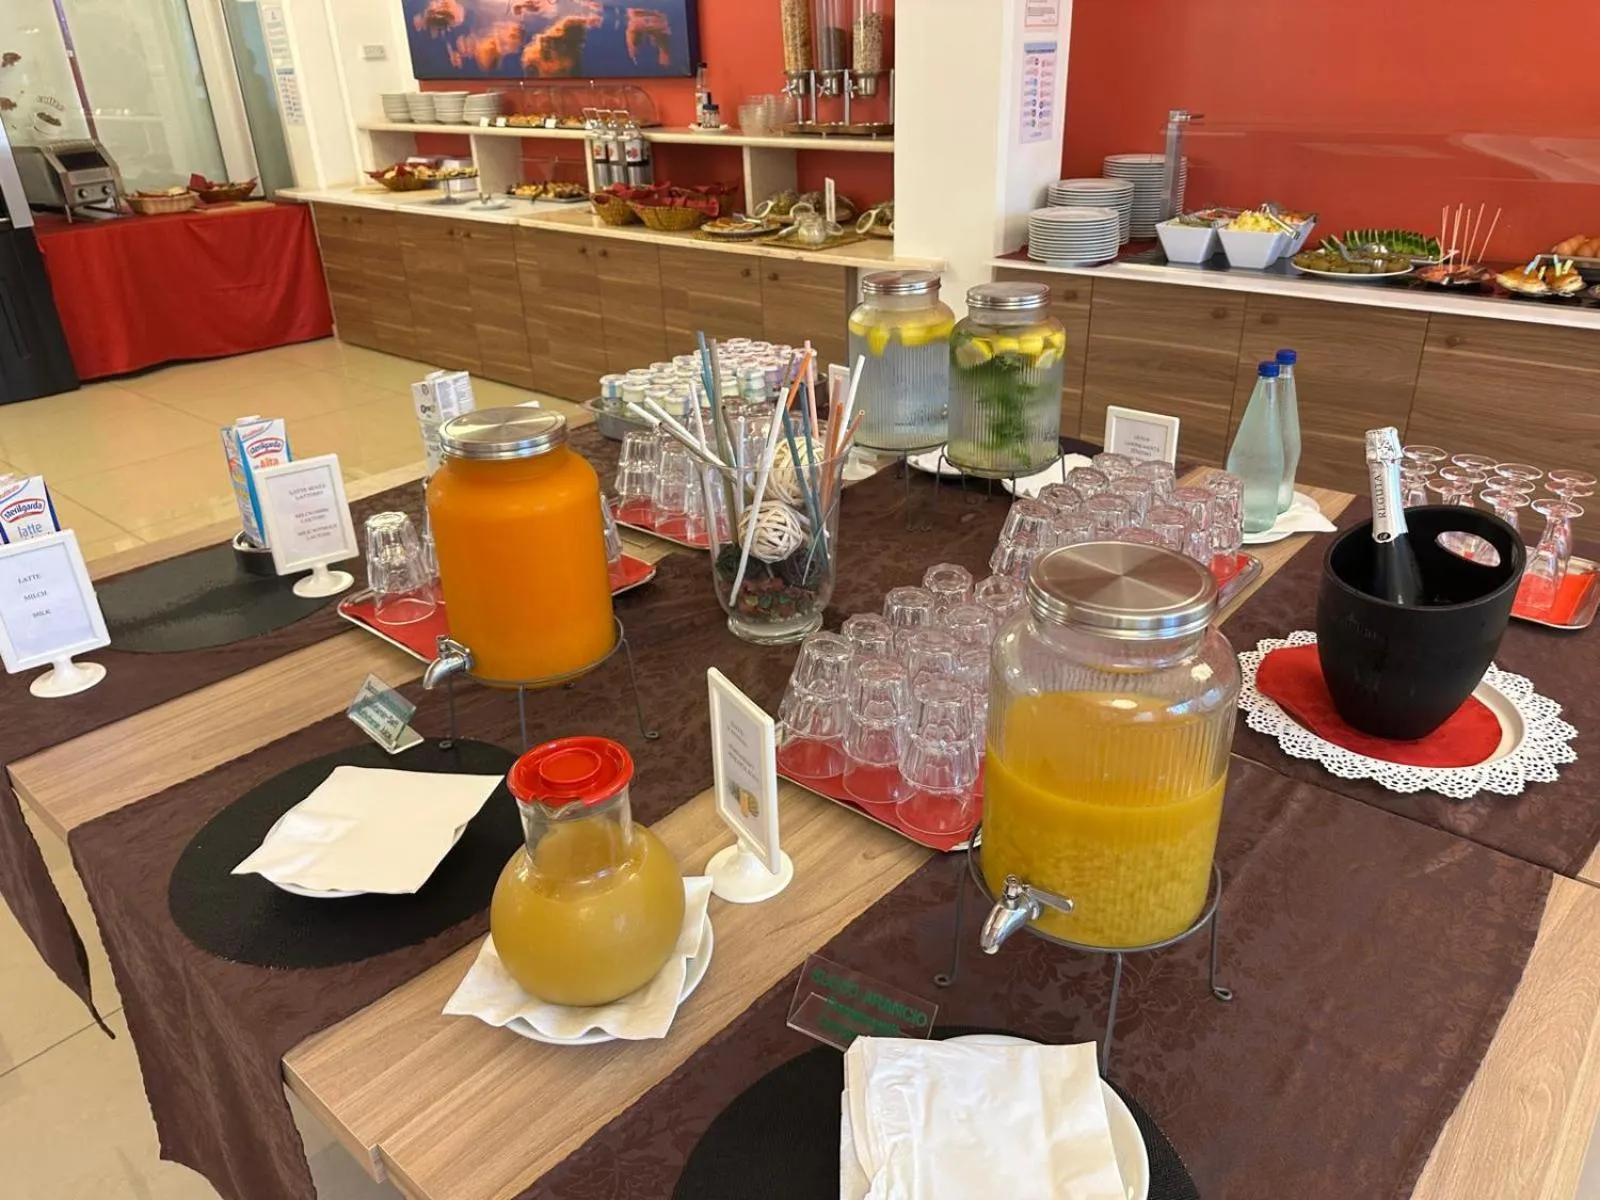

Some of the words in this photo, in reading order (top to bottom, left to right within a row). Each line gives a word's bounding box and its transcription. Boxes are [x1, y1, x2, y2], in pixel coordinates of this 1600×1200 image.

[1374, 474, 1386, 518] REGUTA
[4, 501, 42, 519] sterilgarda
[18, 523, 42, 538] latte
[18, 574, 41, 584] LATTE
